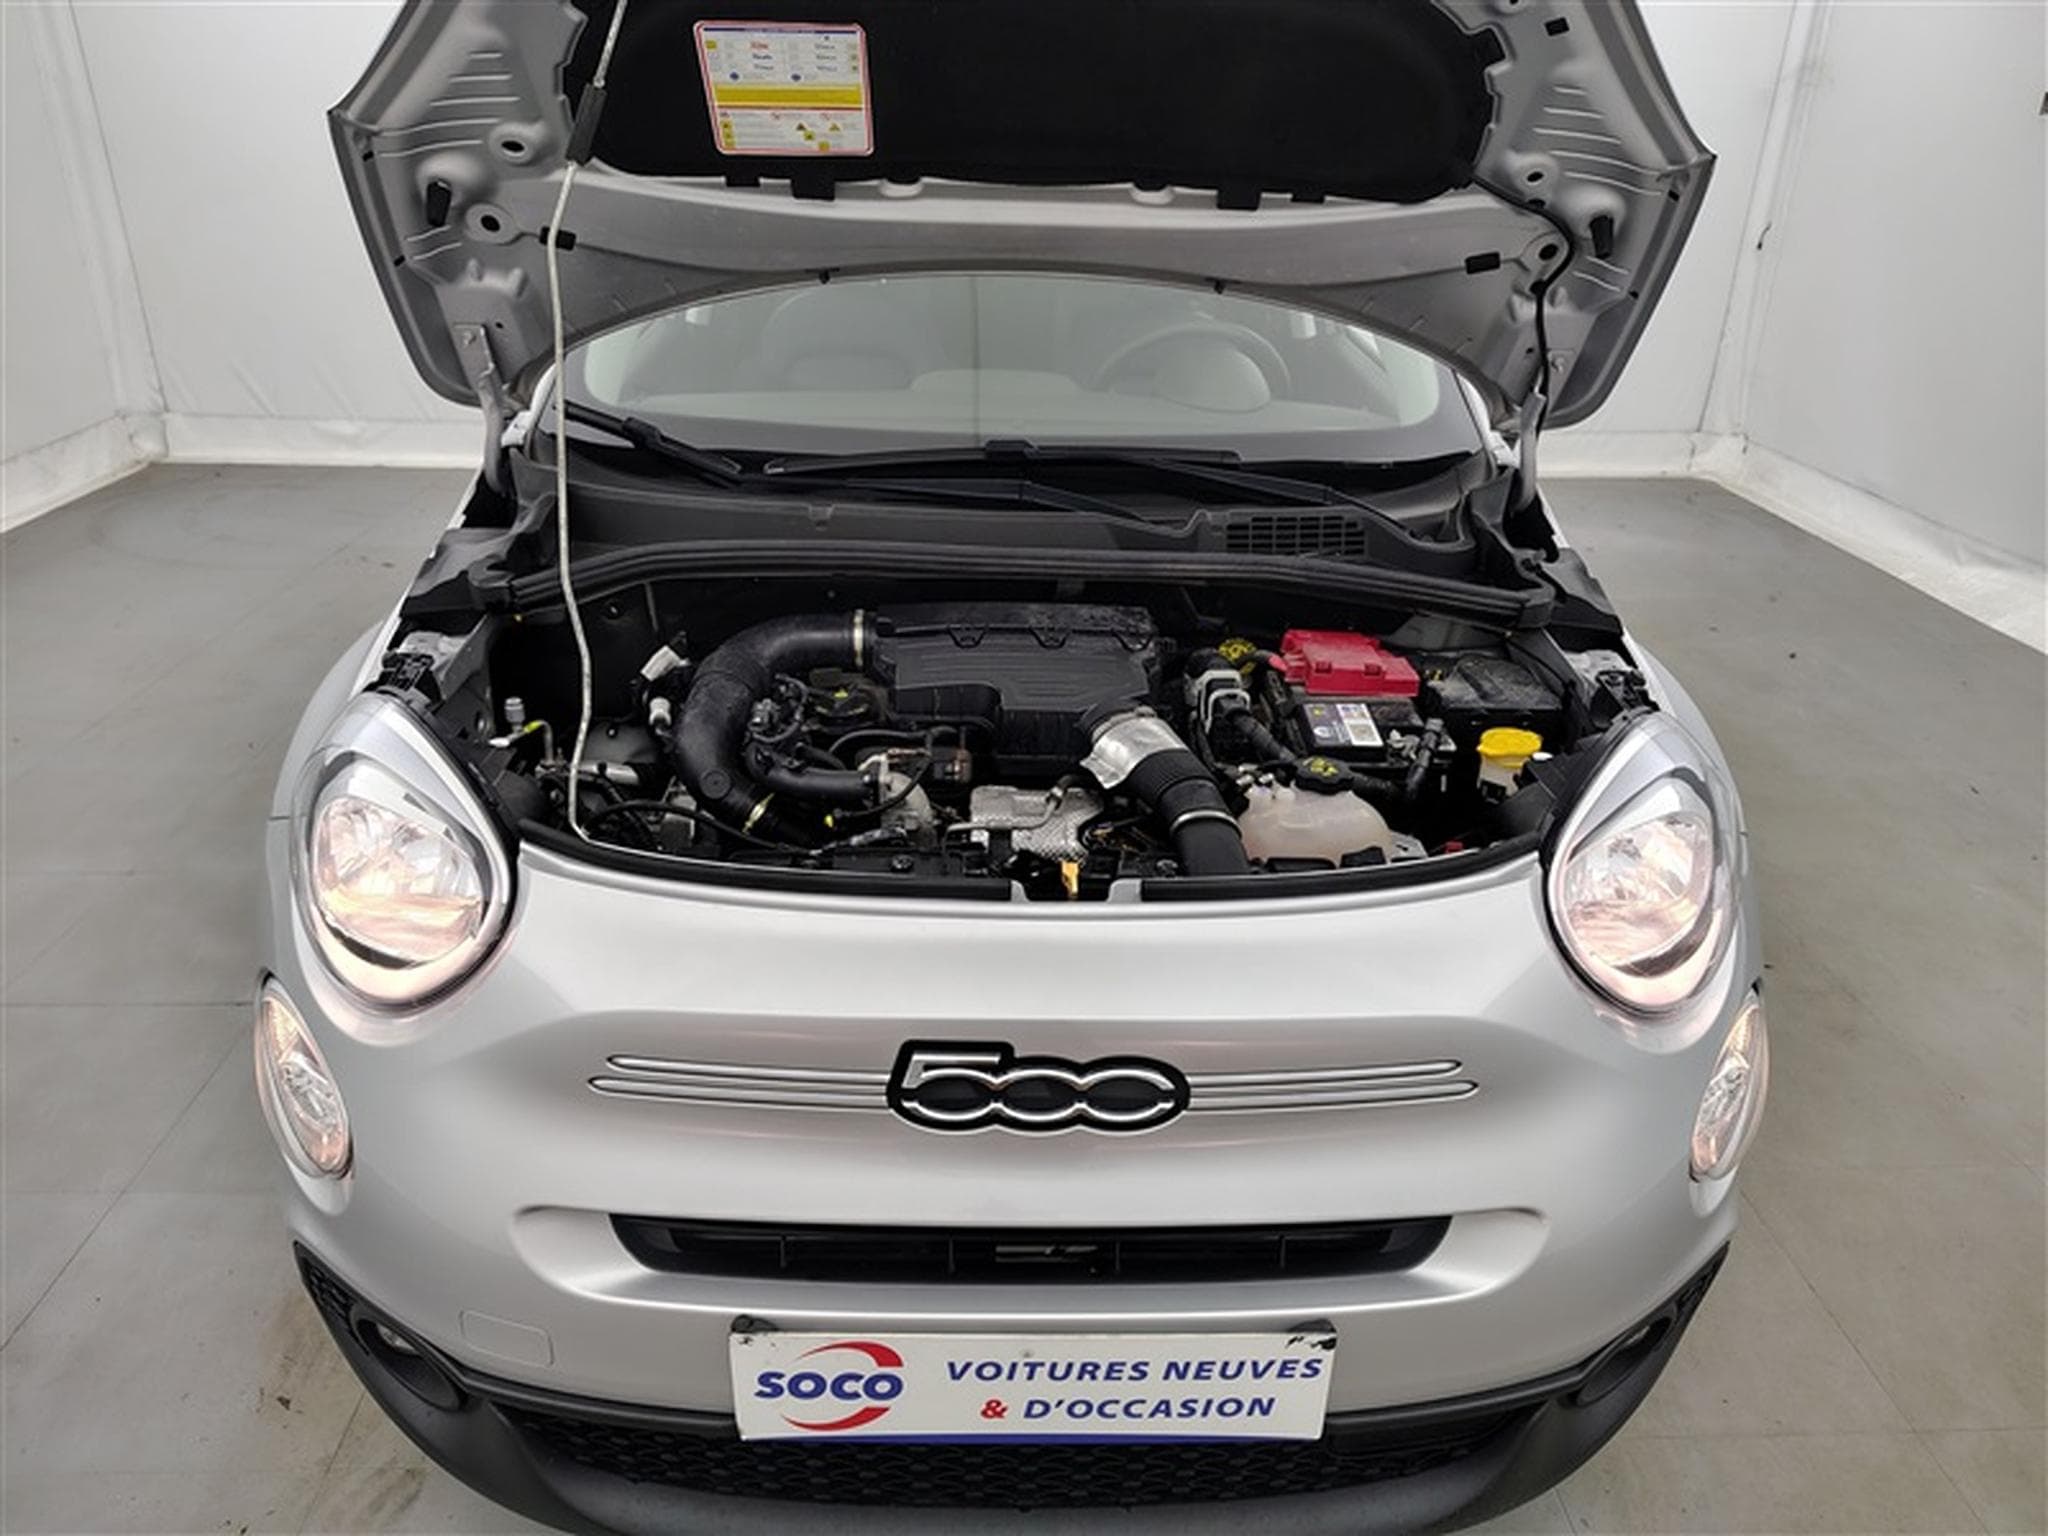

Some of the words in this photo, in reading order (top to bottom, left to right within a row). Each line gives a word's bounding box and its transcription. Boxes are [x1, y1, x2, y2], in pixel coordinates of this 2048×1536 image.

[892, 1045, 1185, 1127] 500
[946, 1360, 1151, 1382] VOITURES
[1162, 1358, 1324, 1381] NEUVES
[754, 1371, 904, 1401] SOCO
[980, 1398, 1008, 1420] &
[1023, 1397, 1276, 1419] D'OCCASION
